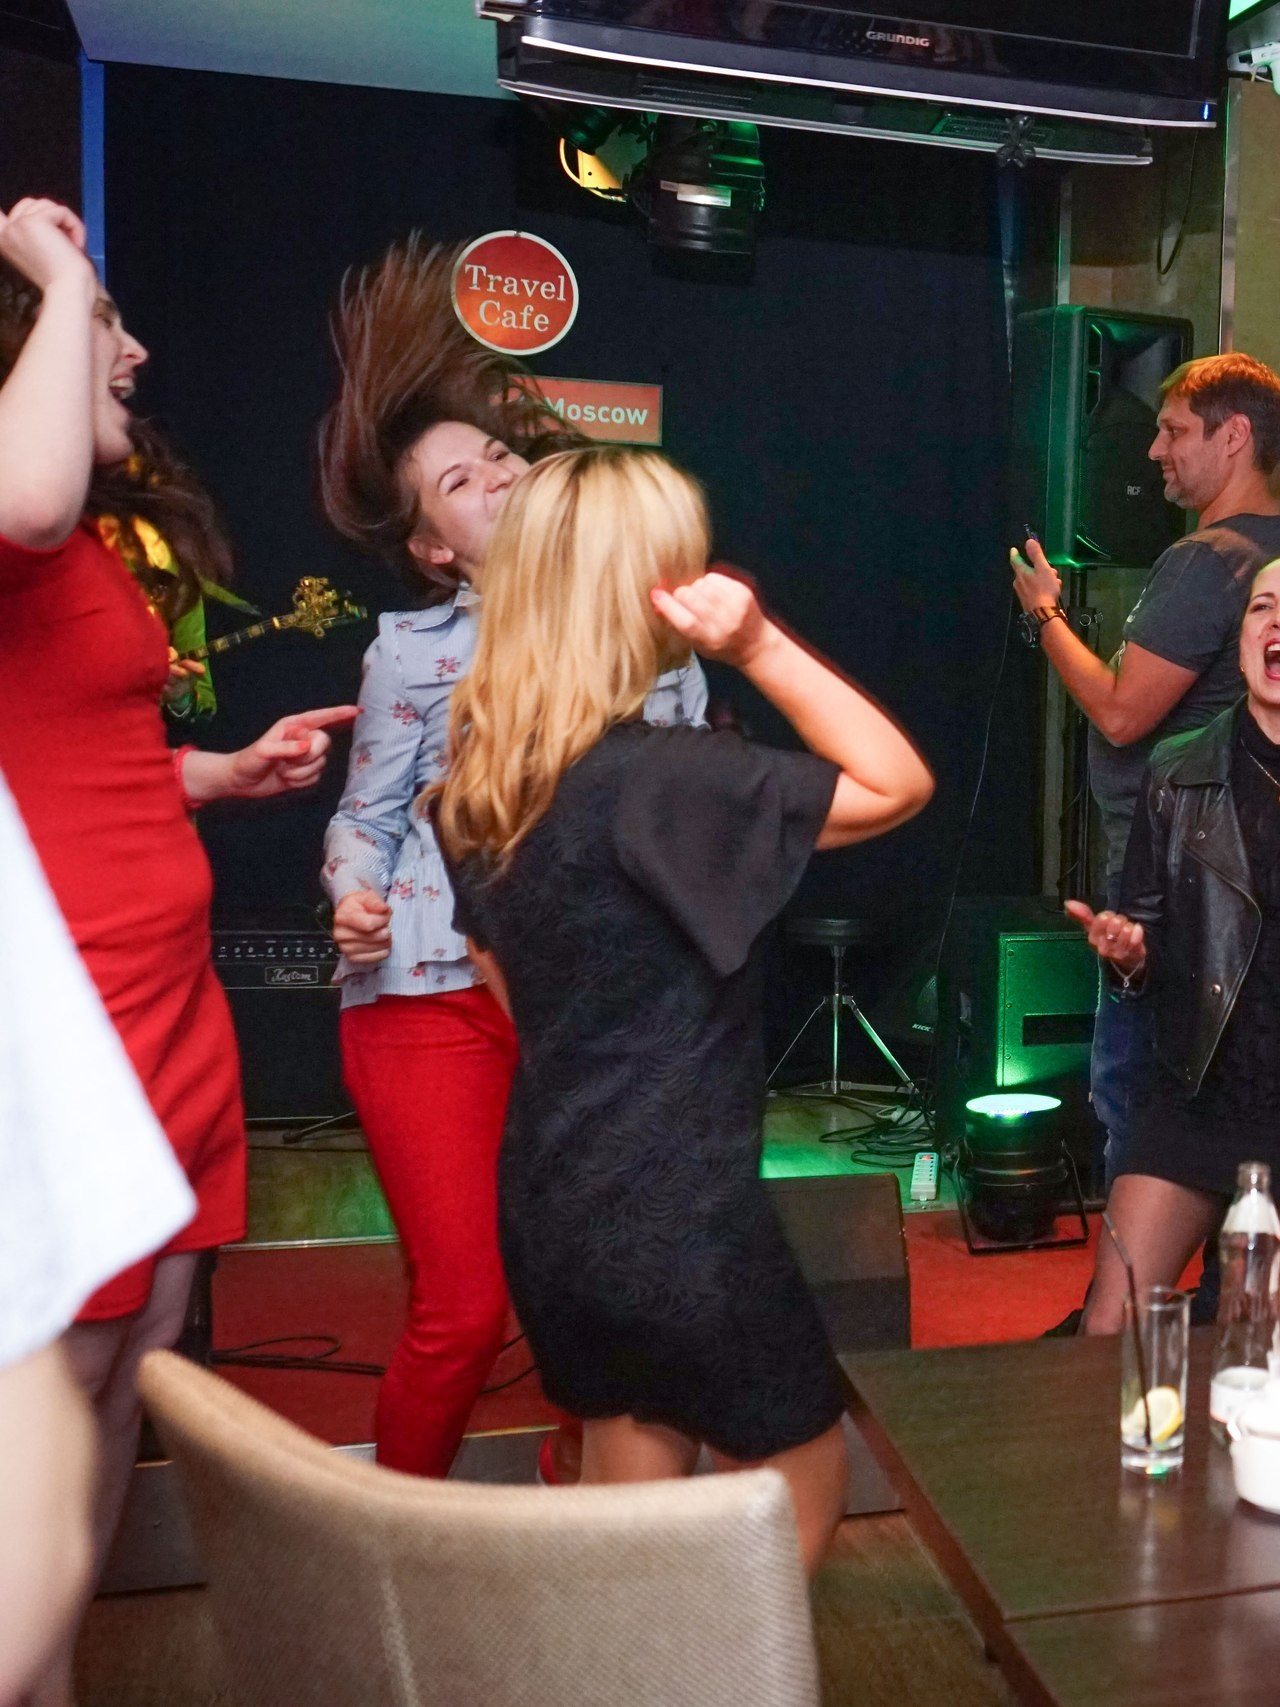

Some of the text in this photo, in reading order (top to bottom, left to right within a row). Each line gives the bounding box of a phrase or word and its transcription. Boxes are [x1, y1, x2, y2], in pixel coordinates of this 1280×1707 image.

[865, 31, 930, 47] GRUNDIG
[464, 264, 566, 301] Travel
[479, 300, 549, 332] Cafe
[544, 397, 648, 425] Moscow
